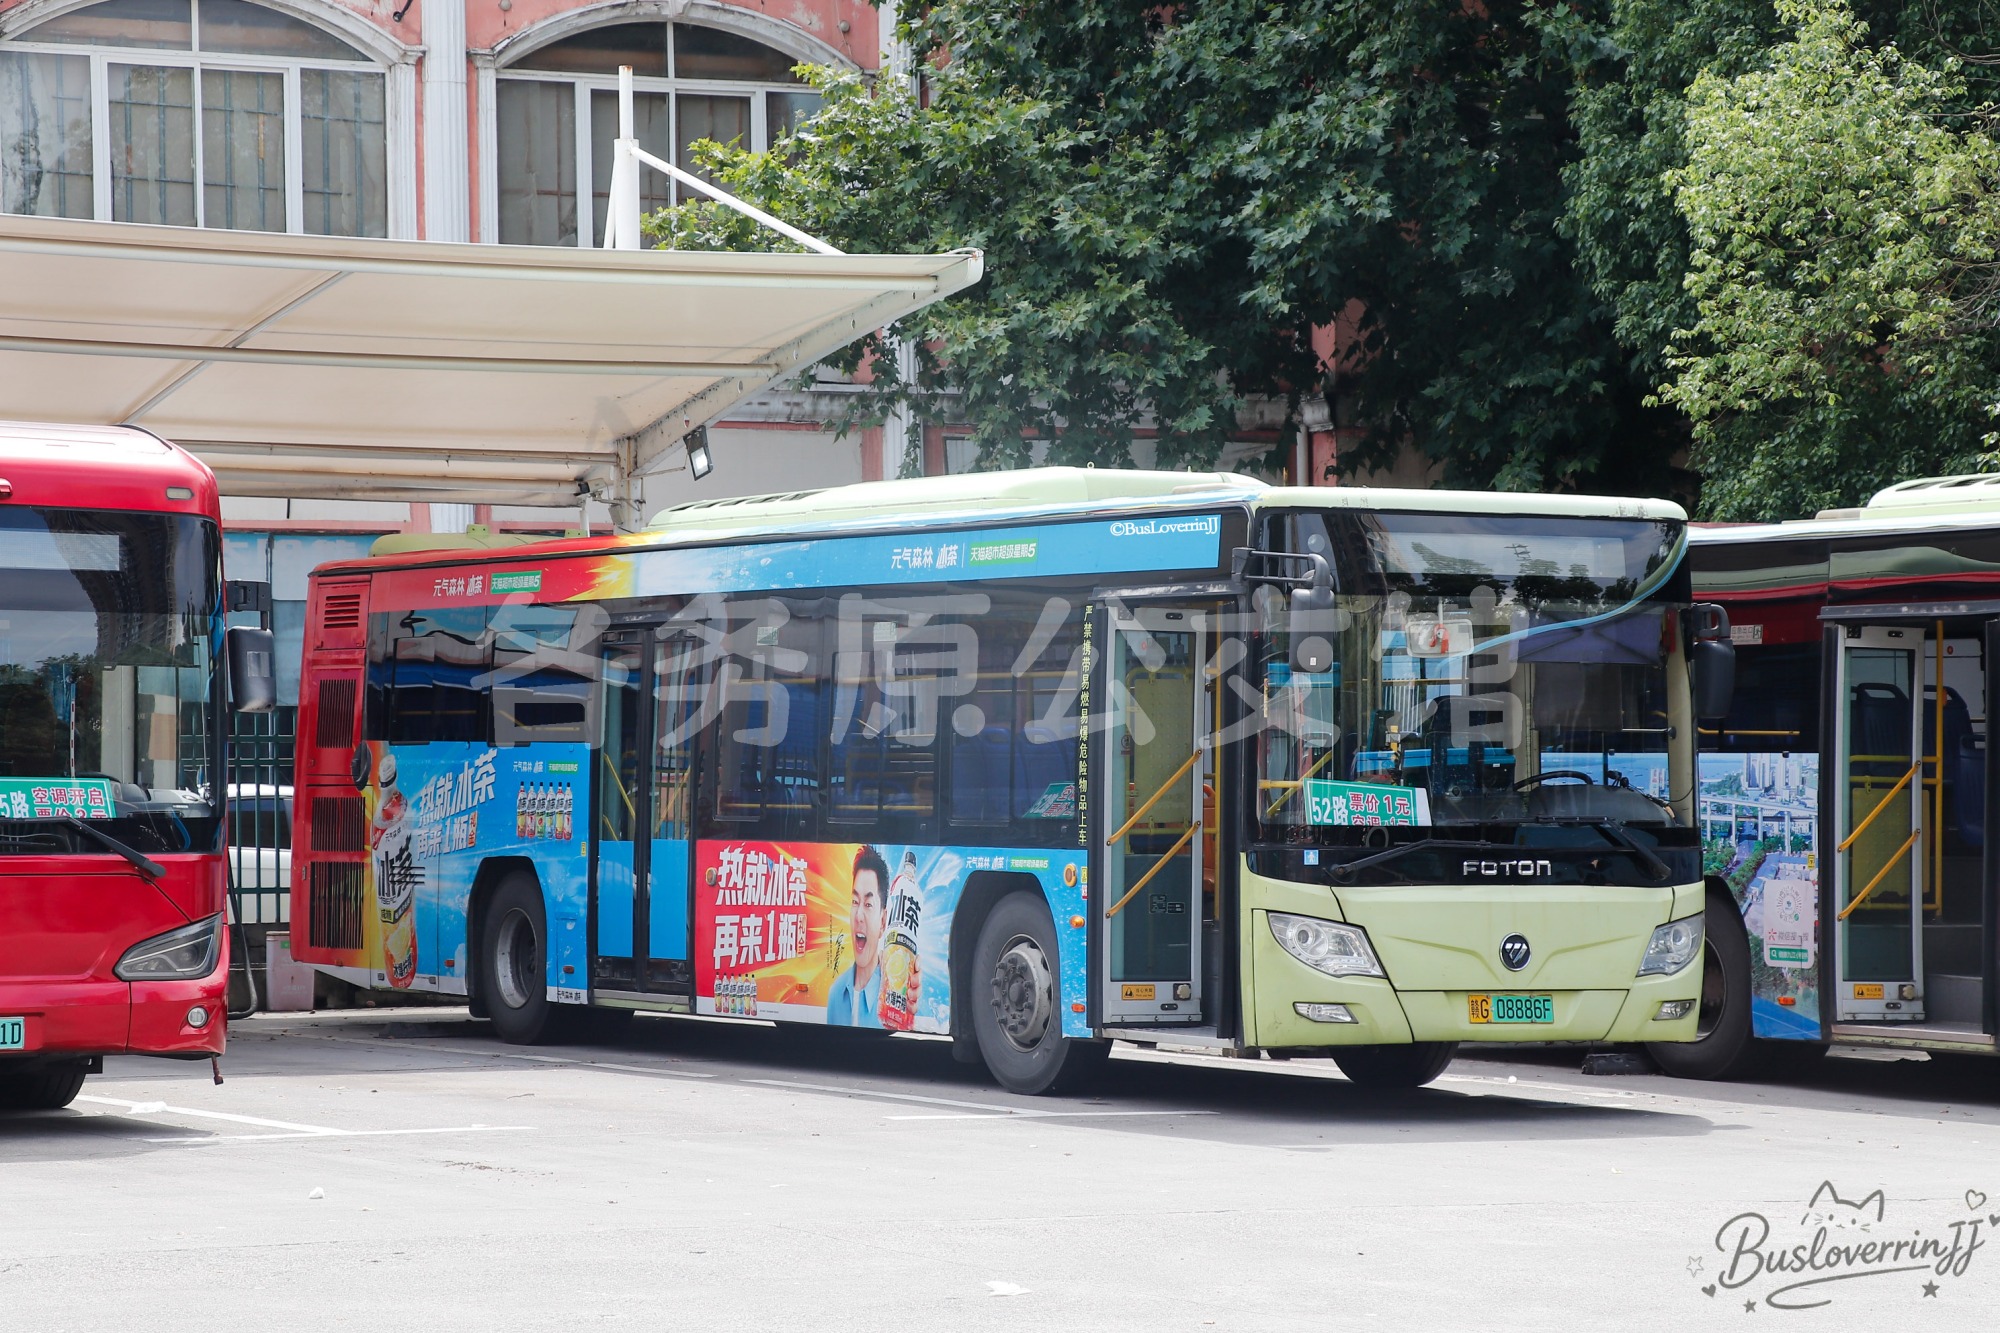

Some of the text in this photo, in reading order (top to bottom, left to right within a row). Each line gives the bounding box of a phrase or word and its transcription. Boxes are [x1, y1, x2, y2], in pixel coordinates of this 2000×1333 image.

[891, 544, 958, 569] 元气森林 冰茶
[970, 543, 1036, 561] 天猫超市超级星期5
[433, 574, 483, 597] 元气森林 冰茶
[1078, 605, 1093, 847] 严禁携带易燃易爆危险物品上车
[32, 787, 105, 806] 空调开启
[419, 749, 497, 828] 热就冰茶
[1312, 795, 1349, 826] 52路
[1350, 792, 1411, 816] 票价1元
[417, 814, 469, 861] 再来1瓶
[716, 843, 808, 906] 热就冰茶
[966, 856, 990, 869] 元气森林
[1463, 860, 1552, 876] FOTON
[713, 910, 797, 970] 再来1瓶
[1497, 998, 1550, 1019] 08886F
